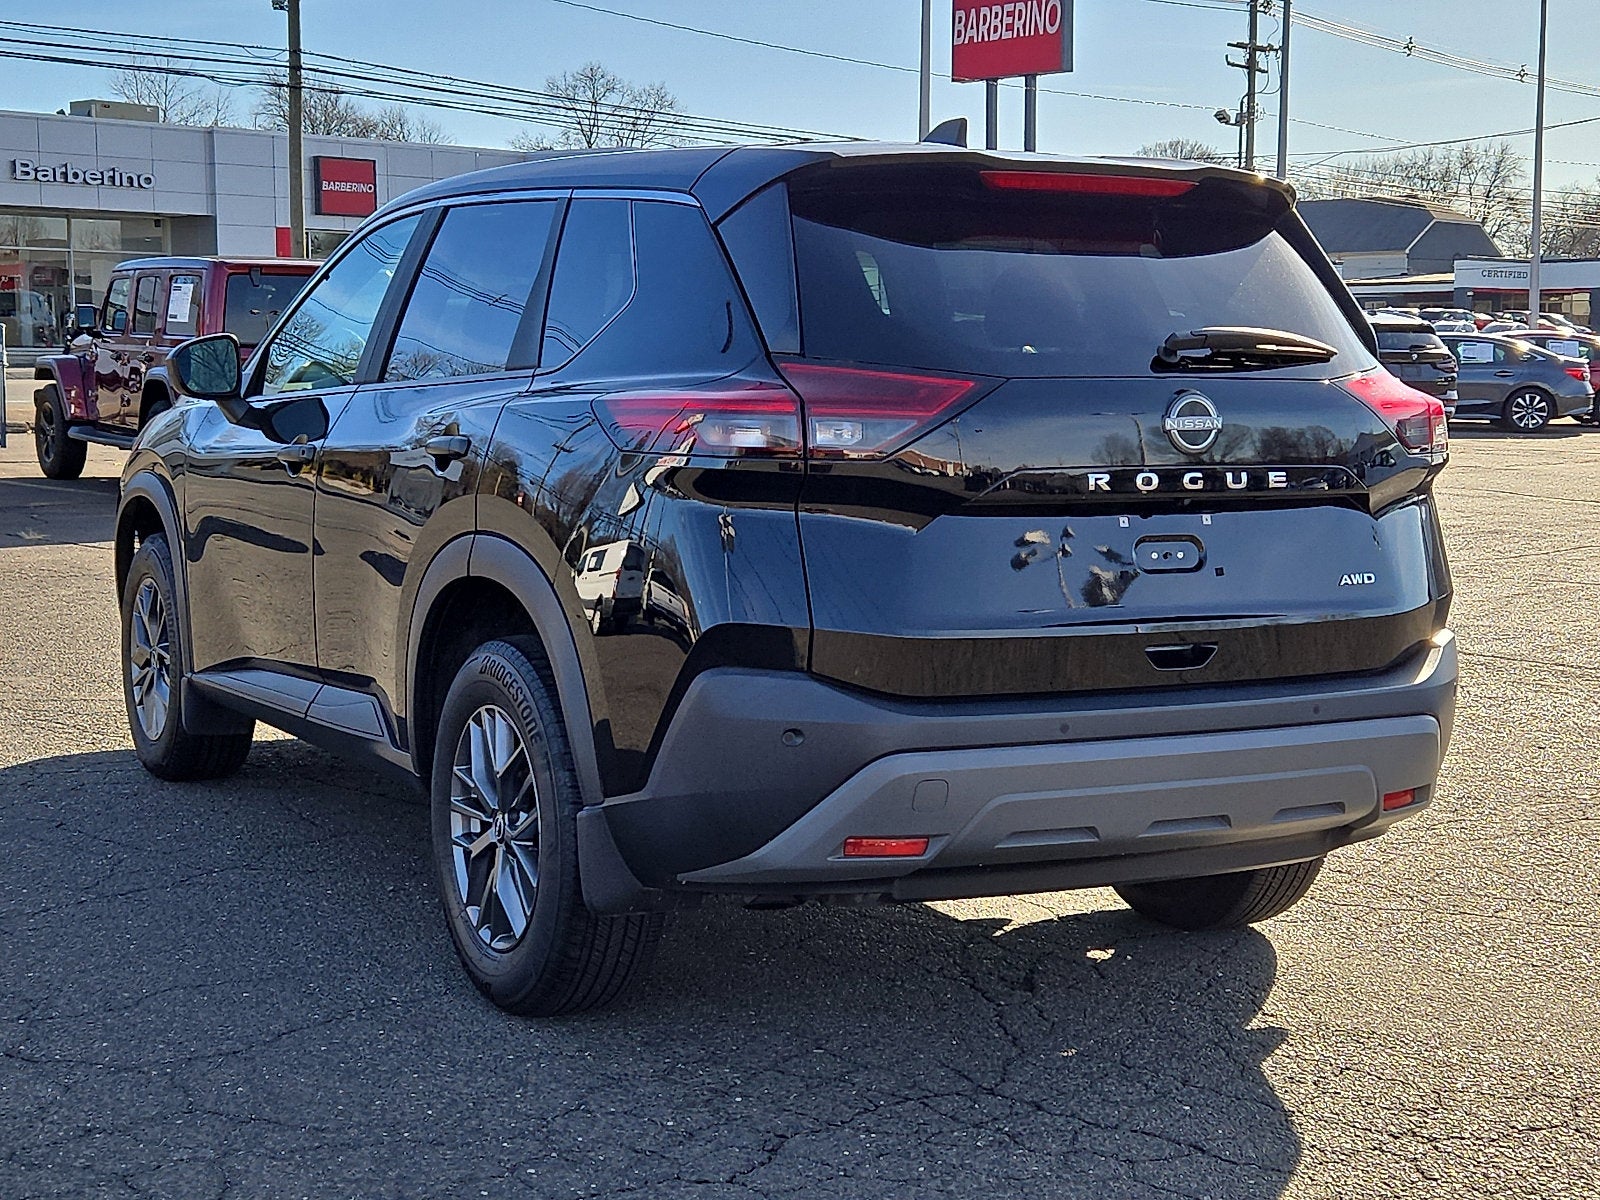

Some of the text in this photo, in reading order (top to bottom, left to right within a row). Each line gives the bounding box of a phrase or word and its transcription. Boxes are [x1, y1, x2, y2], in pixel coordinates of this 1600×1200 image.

[953, 0, 1062, 45] BARBERINO
[14, 158, 156, 189] Barberino
[322, 180, 375, 193] BARBERINO
[1481, 269, 1529, 279] CERTIFIED
[1165, 416, 1223, 431] NISSAN
[1087, 471, 1288, 492] ROGUE
[1339, 573, 1376, 586] AWD
[479, 655, 541, 746] BRIDGESTONE
